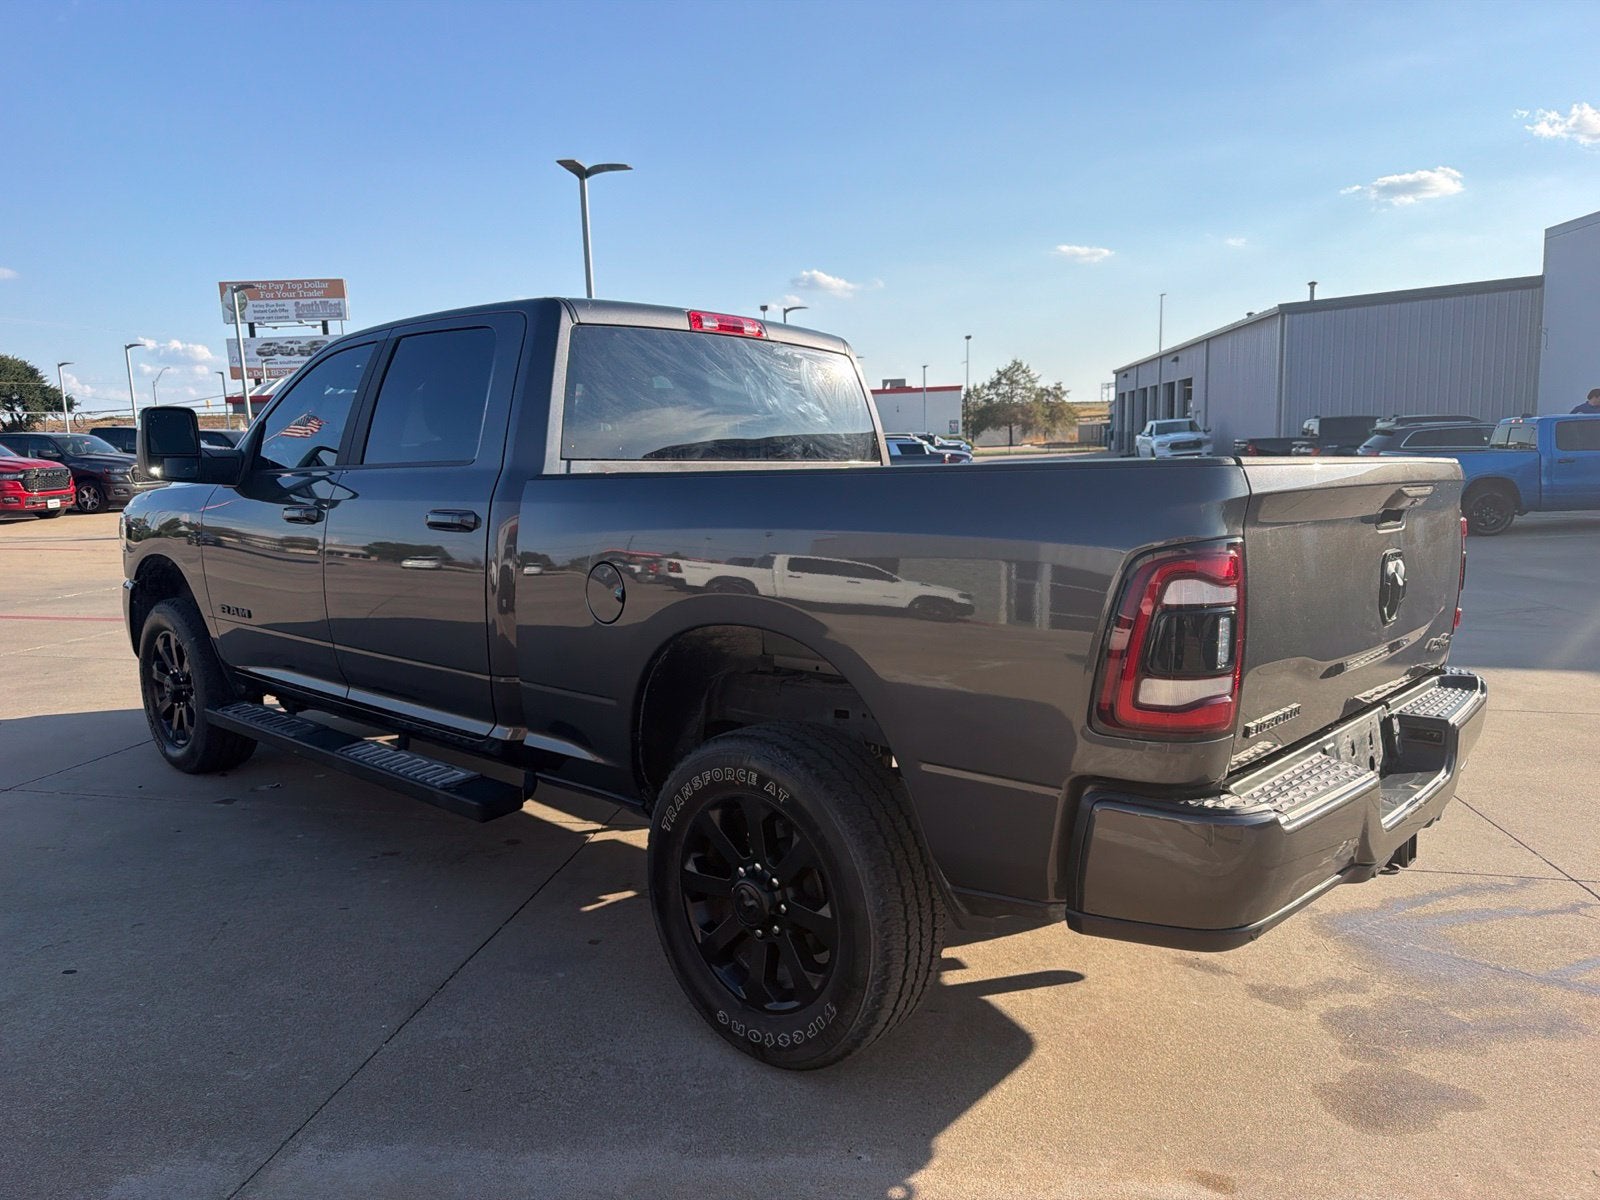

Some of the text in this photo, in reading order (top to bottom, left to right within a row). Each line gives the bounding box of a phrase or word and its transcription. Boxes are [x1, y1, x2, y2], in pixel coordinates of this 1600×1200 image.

[268, 282, 284, 291] Pay
[287, 282, 303, 290] Top
[304, 281, 329, 289] Dollar
[276, 290, 296, 298] Your
[299, 289, 324, 297] Trade!
[660, 767, 790, 833] TRANSFORCE AT
